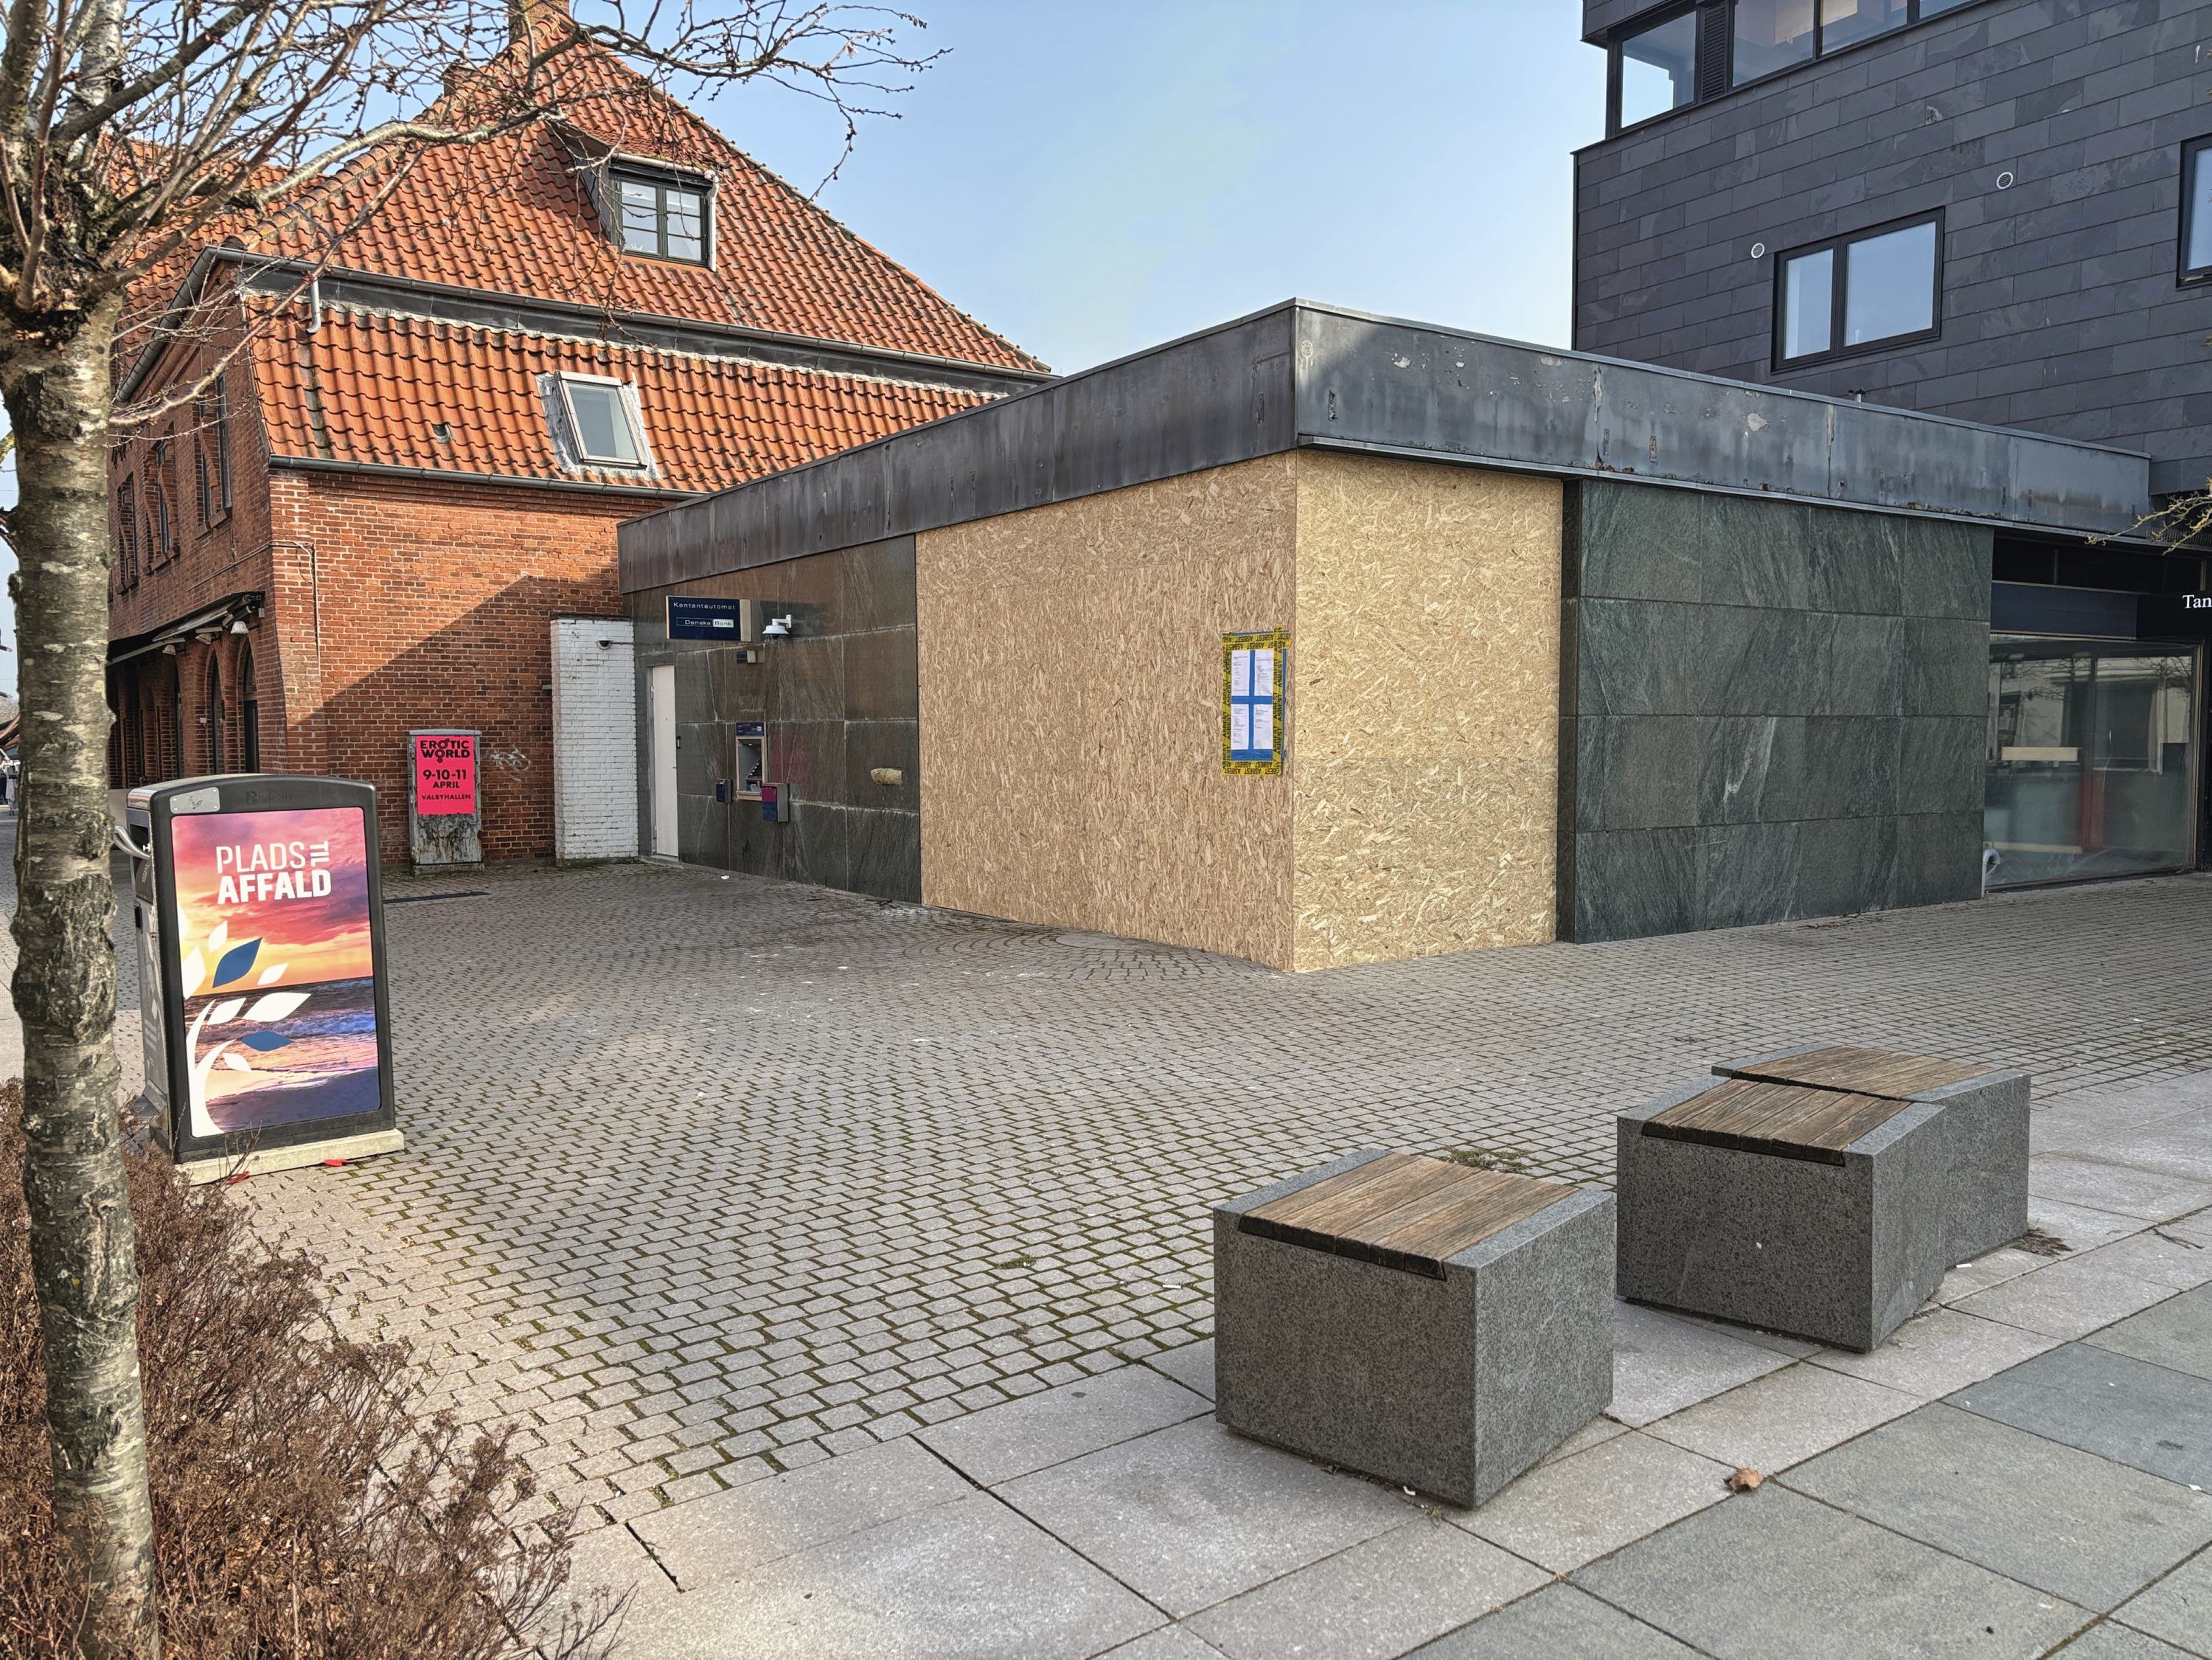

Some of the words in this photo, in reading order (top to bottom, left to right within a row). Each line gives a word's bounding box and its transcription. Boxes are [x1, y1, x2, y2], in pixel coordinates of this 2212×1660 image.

[673, 602, 735, 610] Kontantautomat
[420, 740, 469, 749] EROTIC
[422, 749, 470, 759] WORLD
[422, 769, 467, 780] 9-10-11
[216, 841, 306, 874] PLADS
[310, 841, 330, 867] TIL
[217, 869, 332, 905] AFFALD
